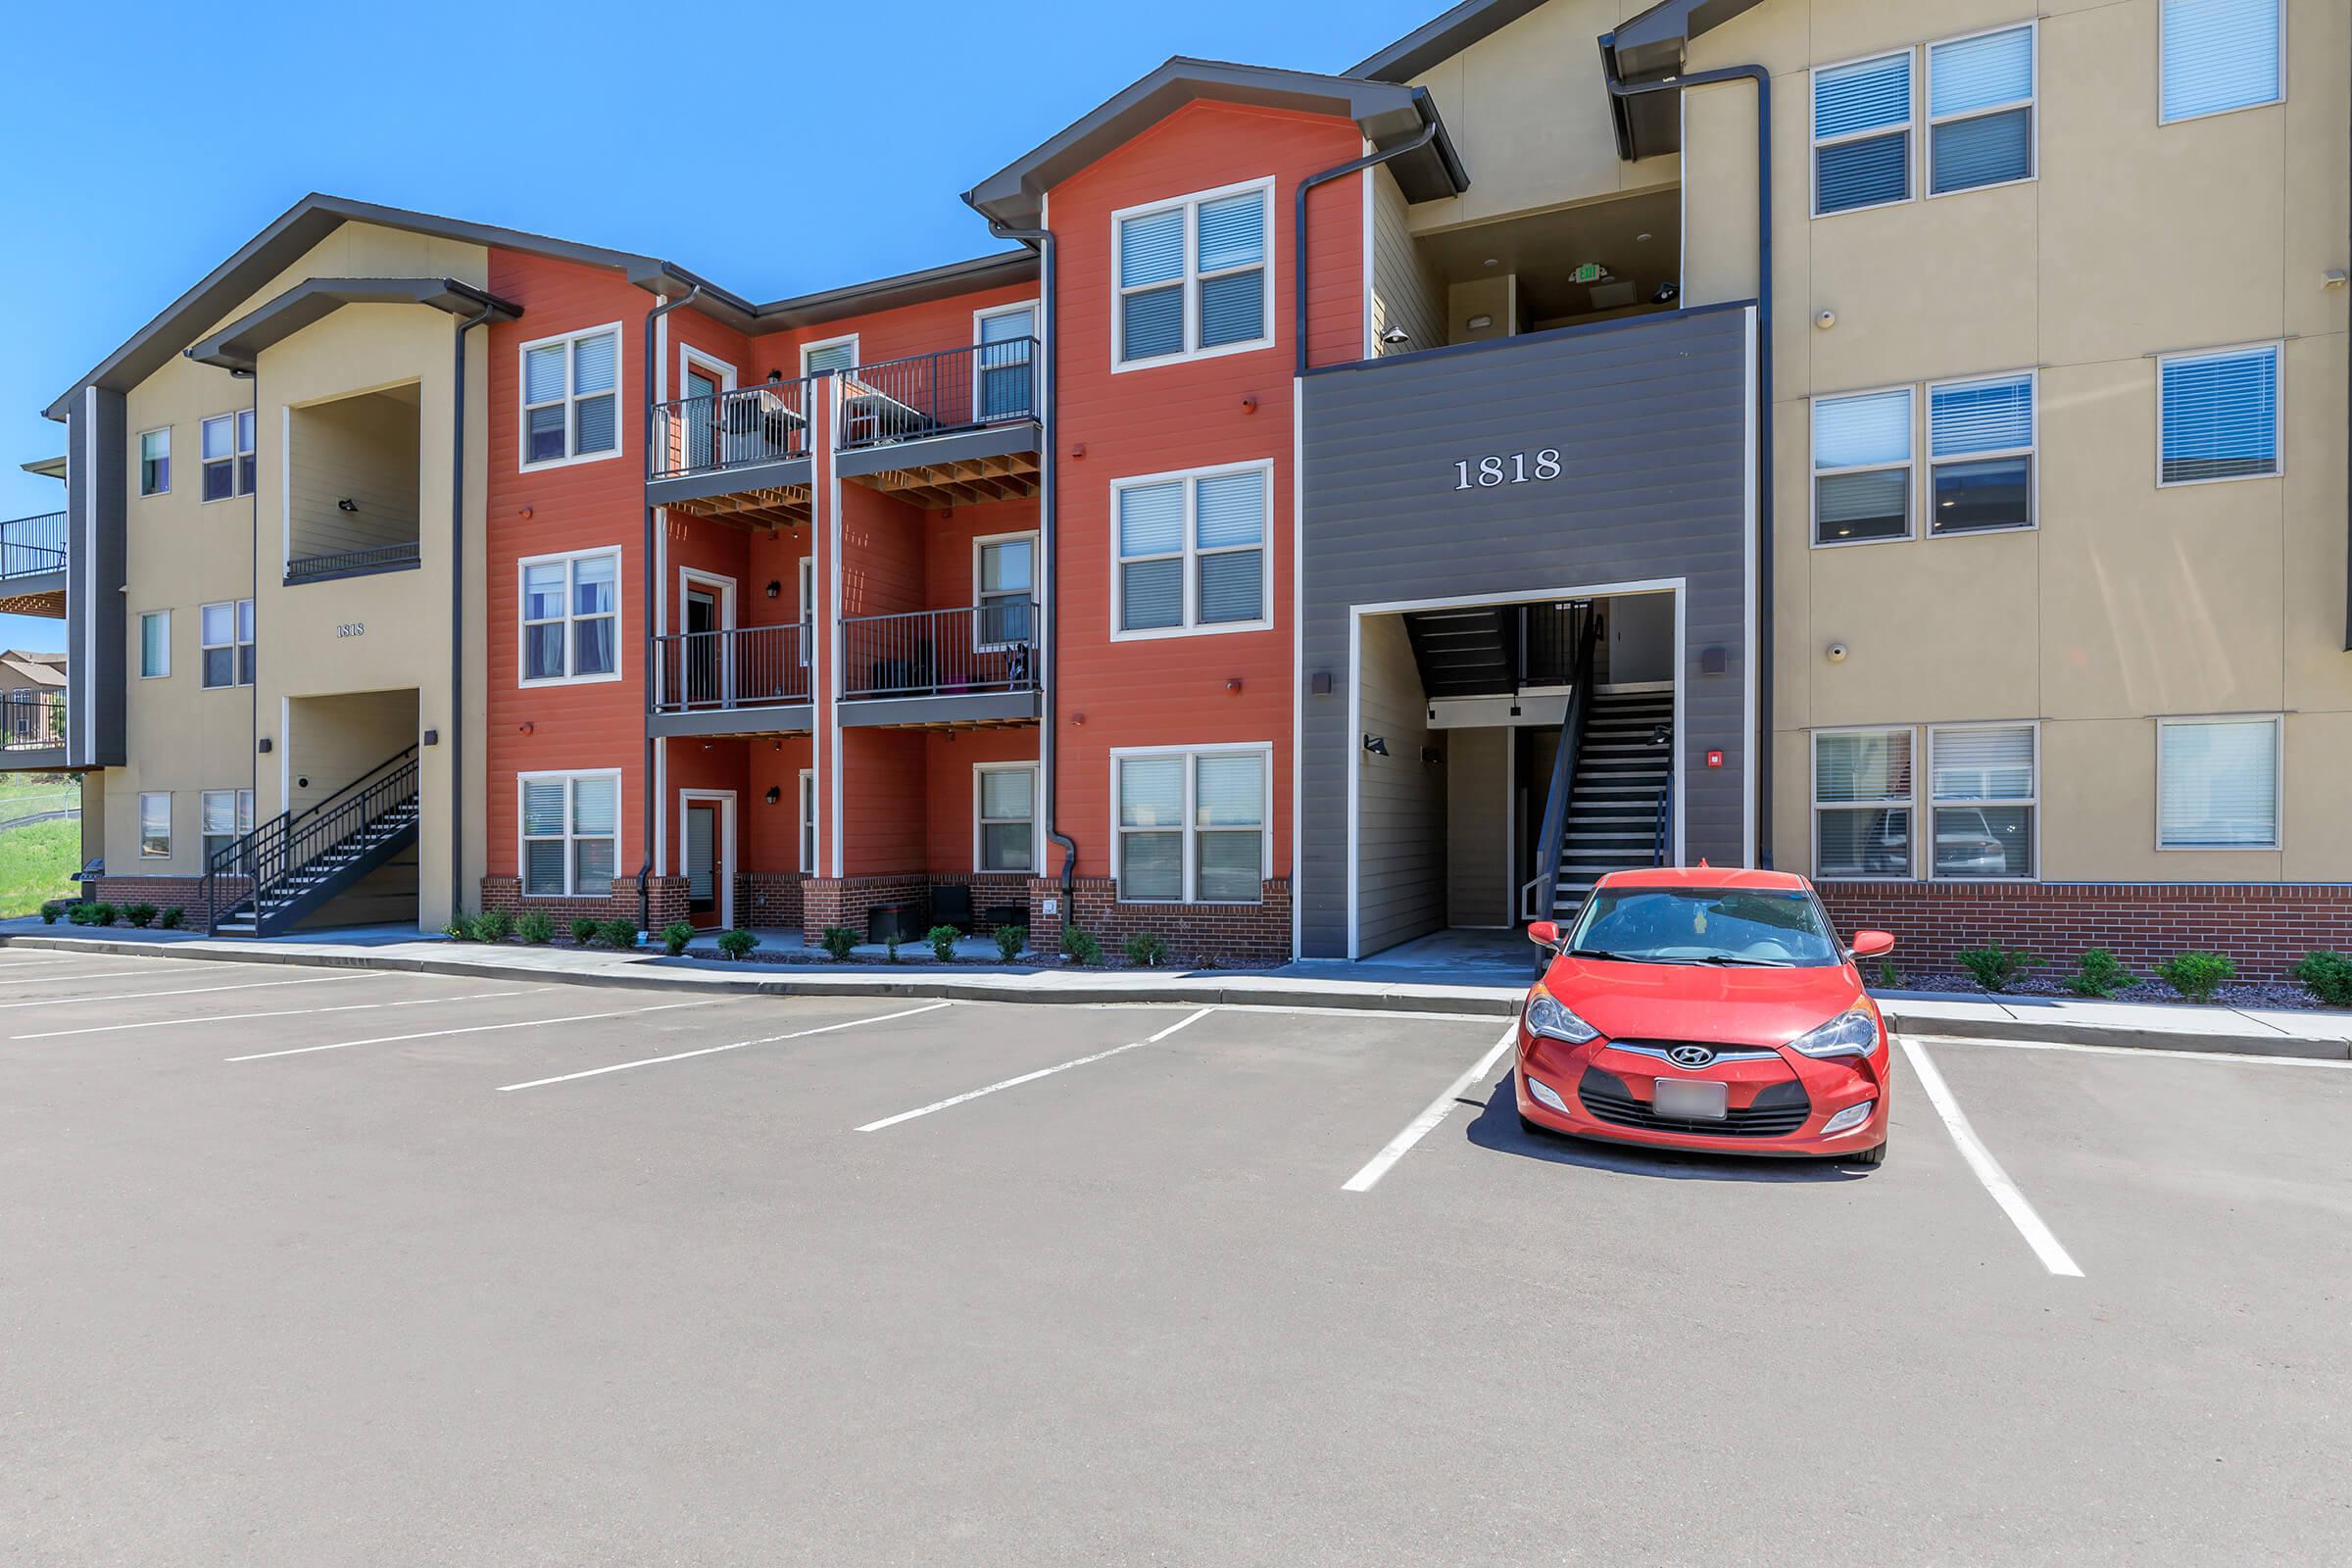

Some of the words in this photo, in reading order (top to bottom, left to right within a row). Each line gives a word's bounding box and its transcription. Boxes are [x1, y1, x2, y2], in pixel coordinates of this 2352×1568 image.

[1580, 266, 1596, 280] EXIT
[1454, 448, 1561, 489] 1818
[336, 622, 365, 638] 1818
